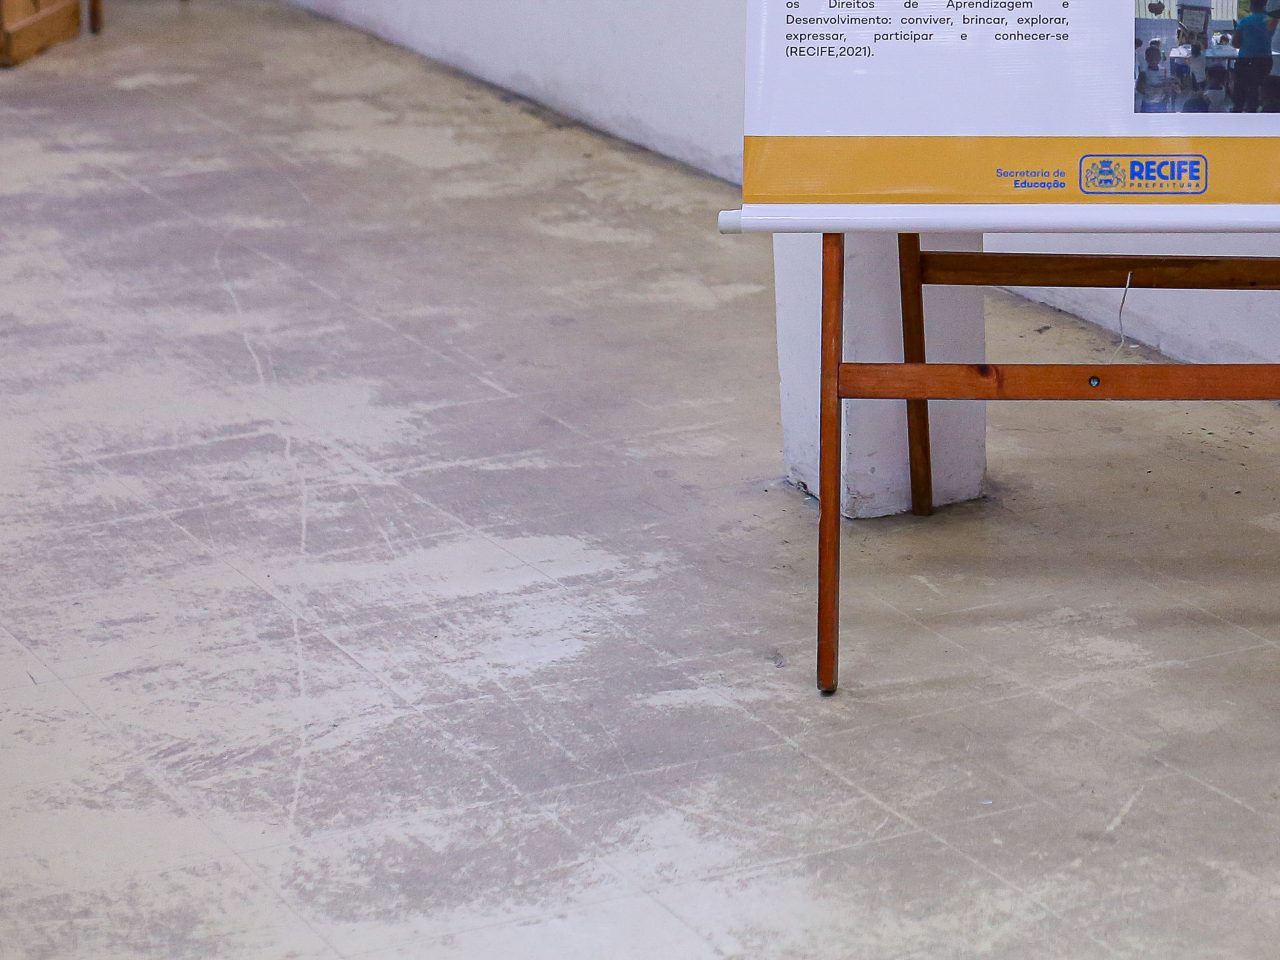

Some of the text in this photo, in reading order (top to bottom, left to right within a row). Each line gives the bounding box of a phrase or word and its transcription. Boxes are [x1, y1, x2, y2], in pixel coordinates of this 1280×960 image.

[785, 13, 1069, 28] Desenvolvimento: conviver, brincar, explorar,
[785, 45, 875, 59] (RECIFE,2021).
[995, 168, 1066, 178] Secretaria de
[1129, 160, 1201, 181] RECIFE
[1013, 178, 1066, 190] Educação
